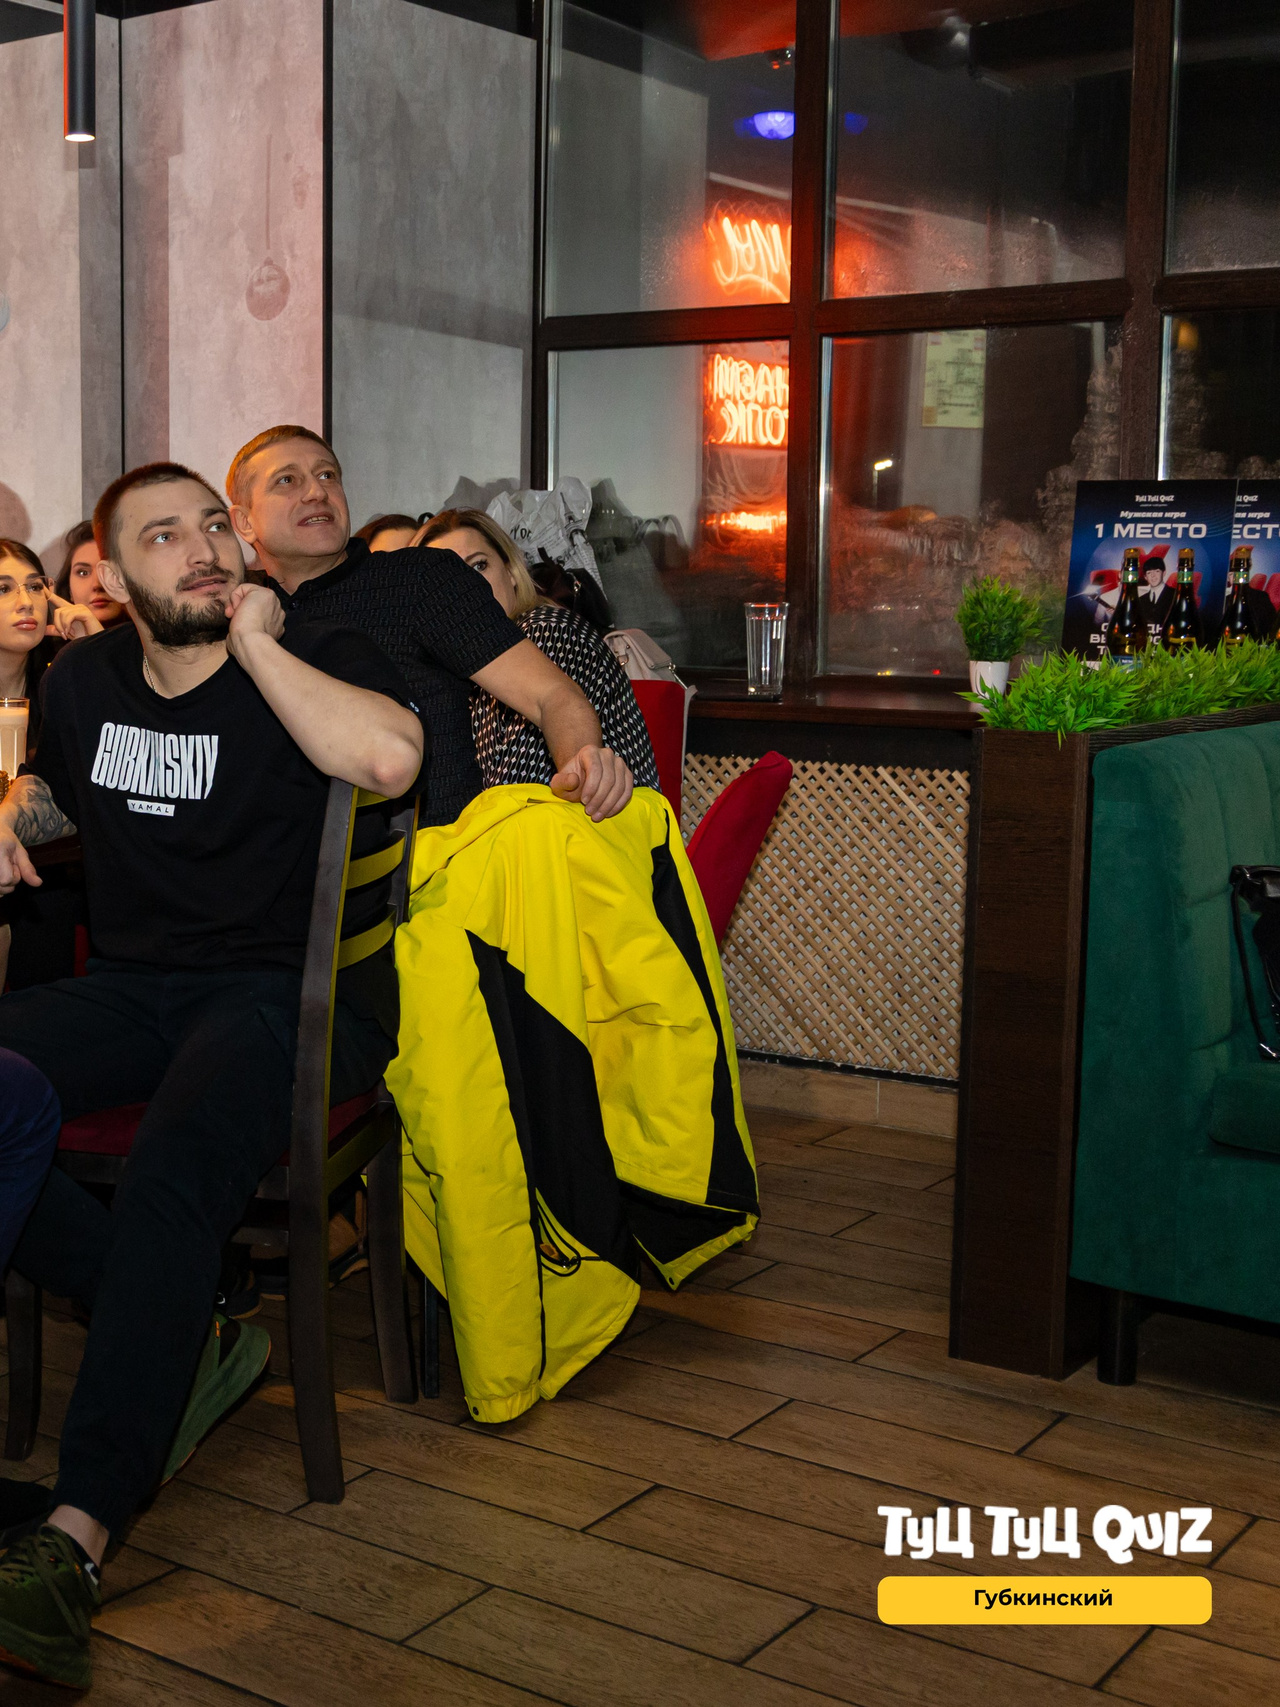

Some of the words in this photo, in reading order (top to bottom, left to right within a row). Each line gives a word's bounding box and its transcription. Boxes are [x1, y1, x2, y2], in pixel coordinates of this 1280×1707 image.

[1120, 511, 1163, 519] Мужская
[1164, 511, 1187, 519] игра
[1095, 523, 1104, 538] 1
[1113, 523, 1207, 539] МЕСТО
[91, 722, 219, 799] GUBKINSKIY
[131, 802, 169, 813] YAMAL
